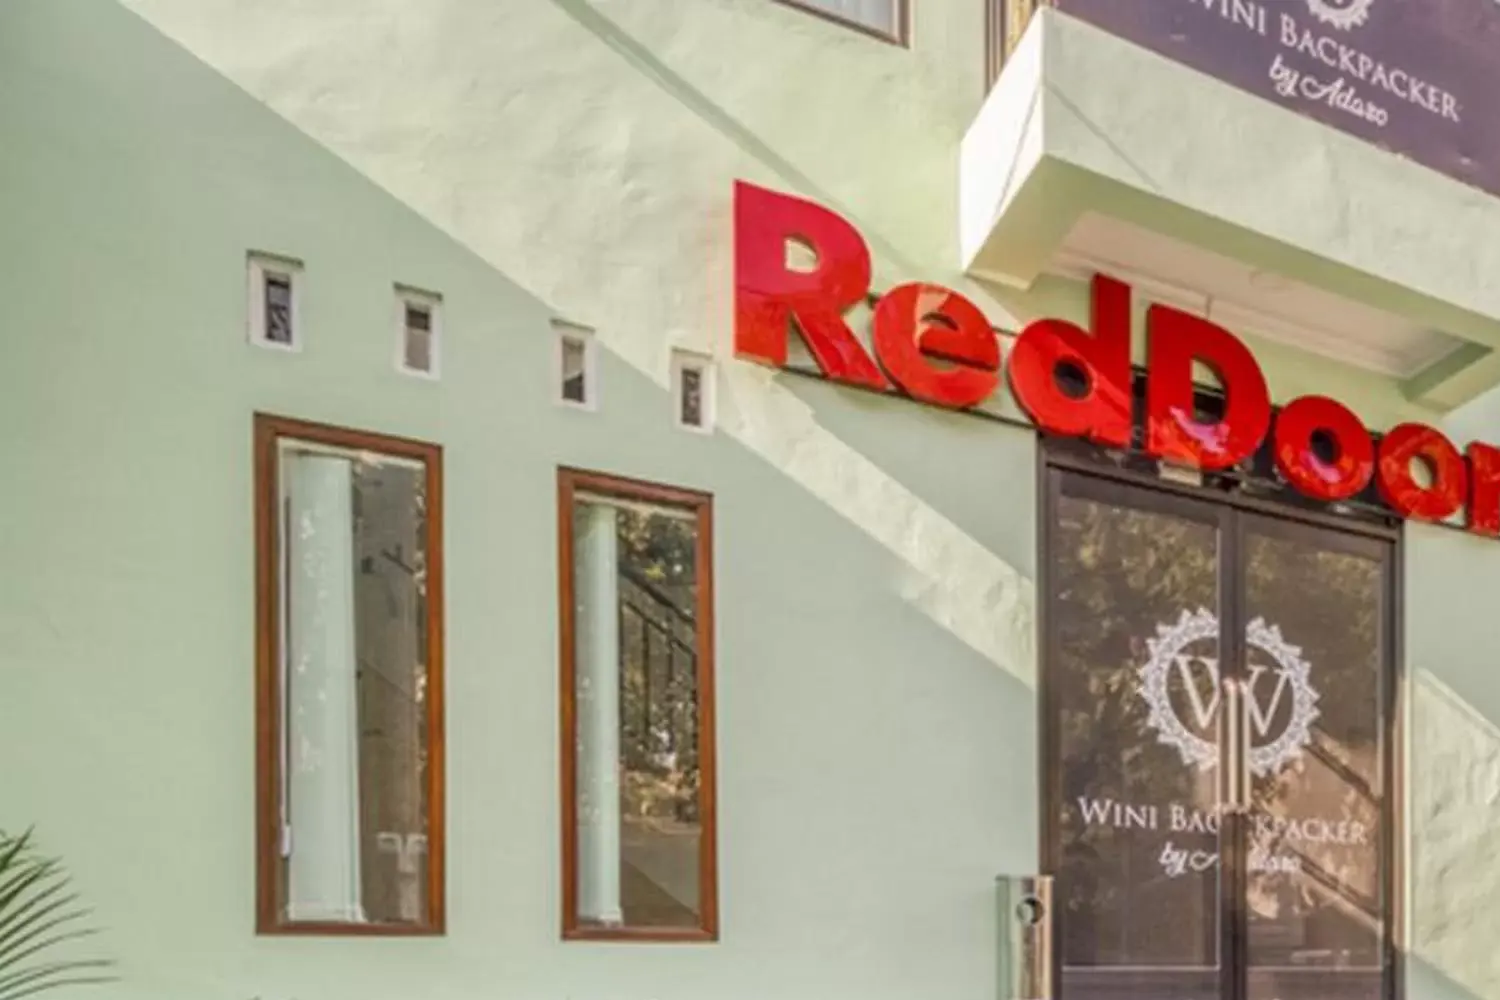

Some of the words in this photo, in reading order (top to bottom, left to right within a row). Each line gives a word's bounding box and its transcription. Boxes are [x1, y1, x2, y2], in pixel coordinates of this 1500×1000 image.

[1188, 0, 1266, 36] INI
[1280, 11, 1463, 122] BACKPACKER
[1268, 53, 1300, 97] by
[1158, 841, 1188, 877] by
